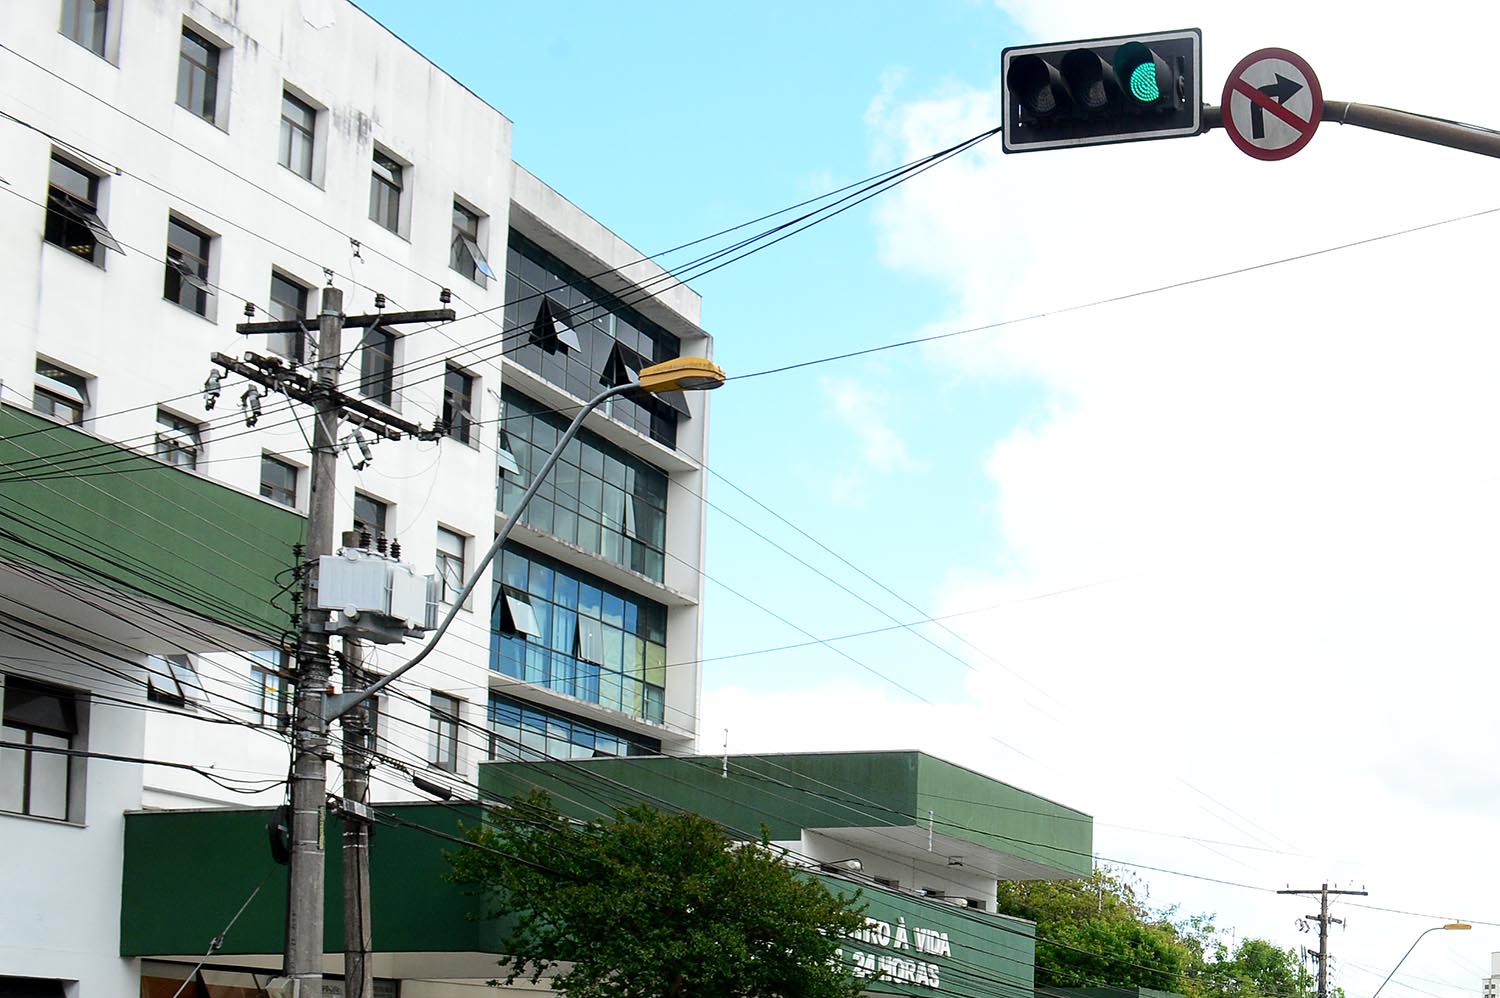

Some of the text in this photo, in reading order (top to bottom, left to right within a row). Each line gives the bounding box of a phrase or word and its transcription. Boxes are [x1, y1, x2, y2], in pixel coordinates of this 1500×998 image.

[894, 916, 908, 950] À
[913, 926, 951, 957] VIDA
[877, 955, 940, 988] HORAS
